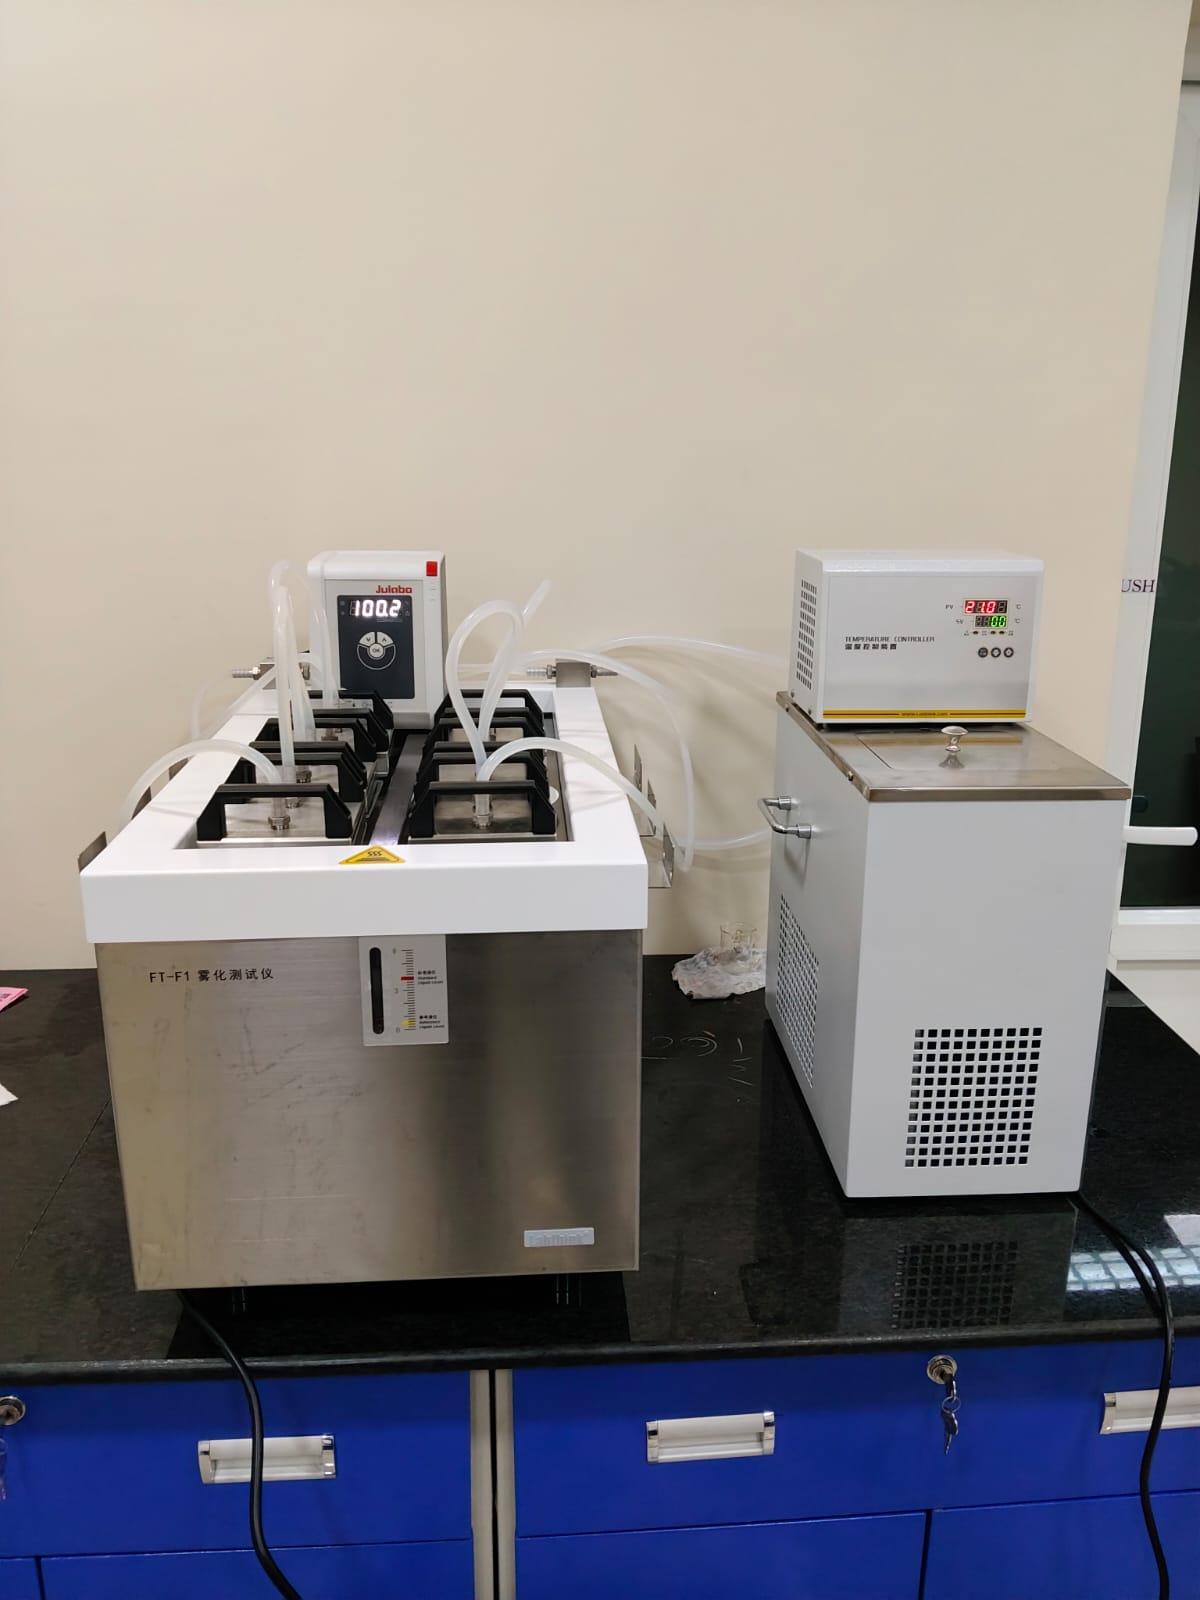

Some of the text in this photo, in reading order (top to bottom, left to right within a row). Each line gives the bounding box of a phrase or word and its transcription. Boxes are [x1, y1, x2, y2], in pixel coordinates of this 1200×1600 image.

[149, 968, 274, 983] FT-F1 雾化测试仪
